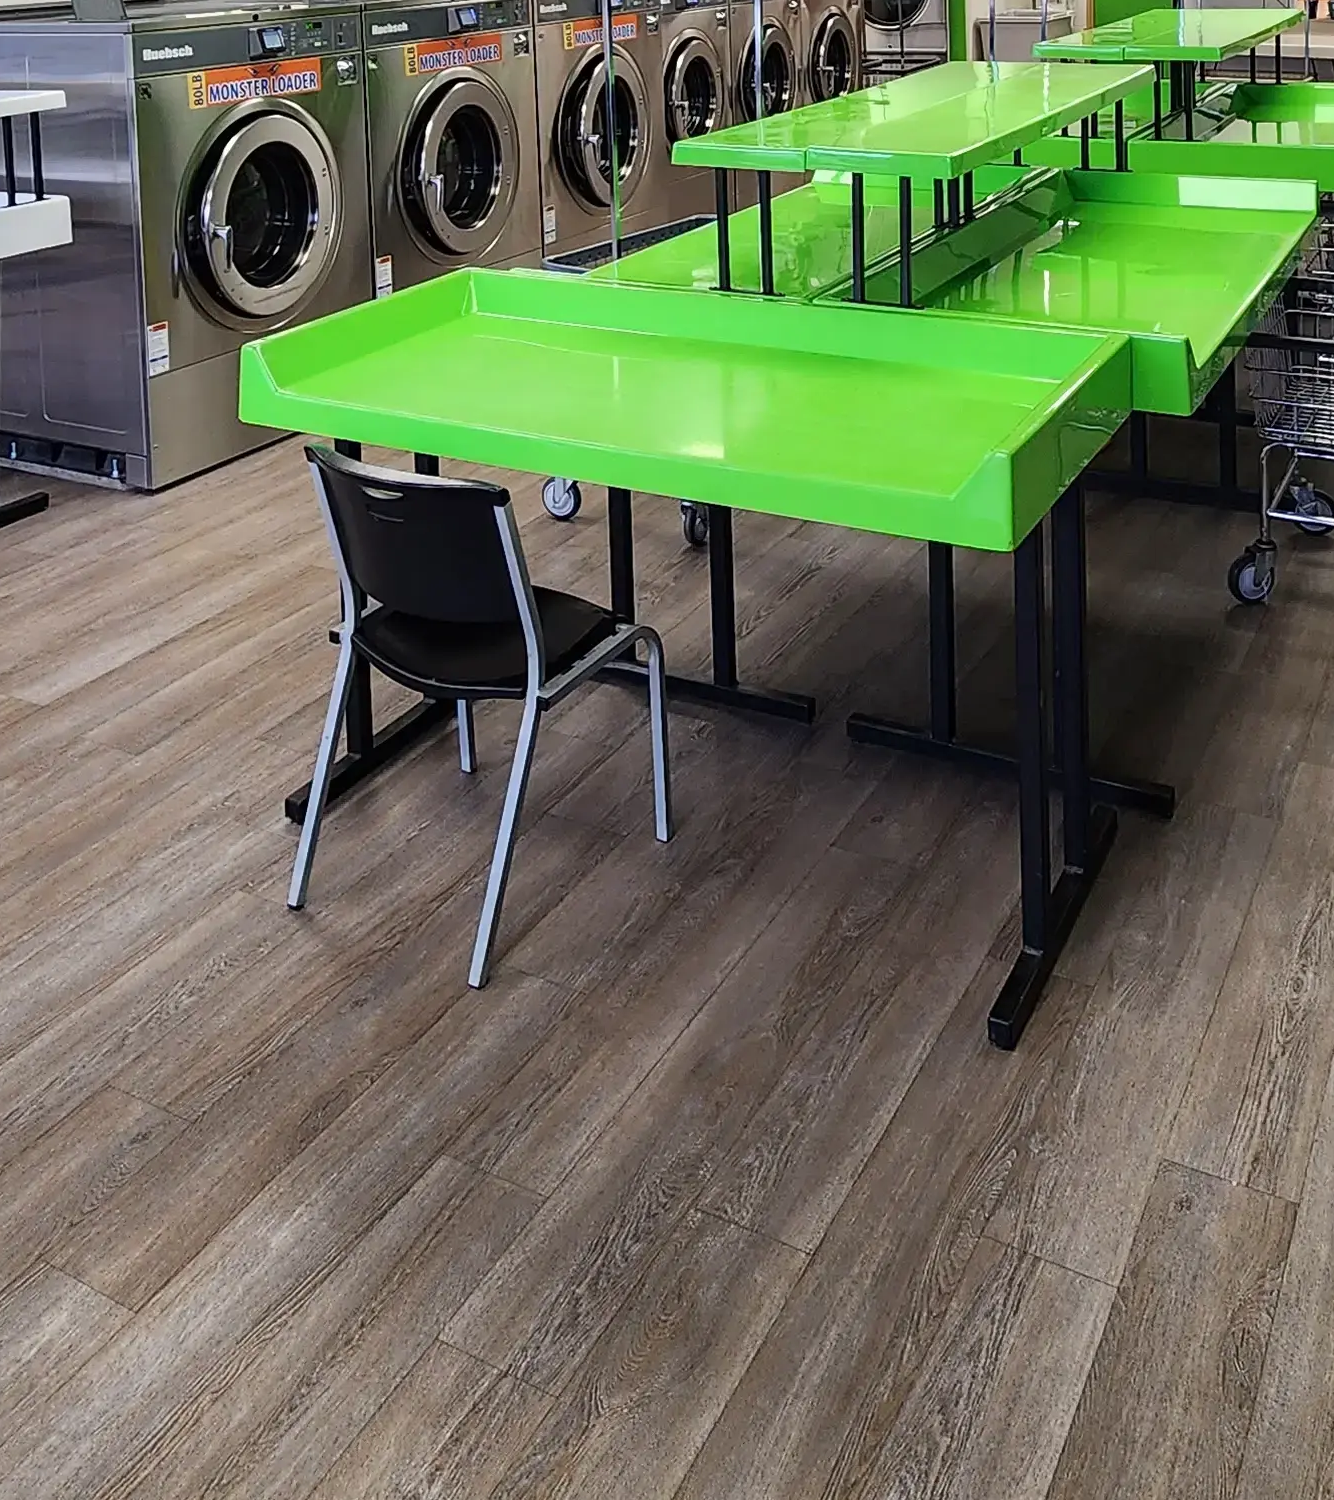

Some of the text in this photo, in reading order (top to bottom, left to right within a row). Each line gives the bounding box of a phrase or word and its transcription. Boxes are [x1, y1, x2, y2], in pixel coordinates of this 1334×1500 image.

[575, 25, 635, 43] MONSTE OADER
[419, 45, 500, 71] MONSTER LOADER
[192, 74, 204, 106] 80LB
[210, 72, 317, 102] MONSTER LOADER
